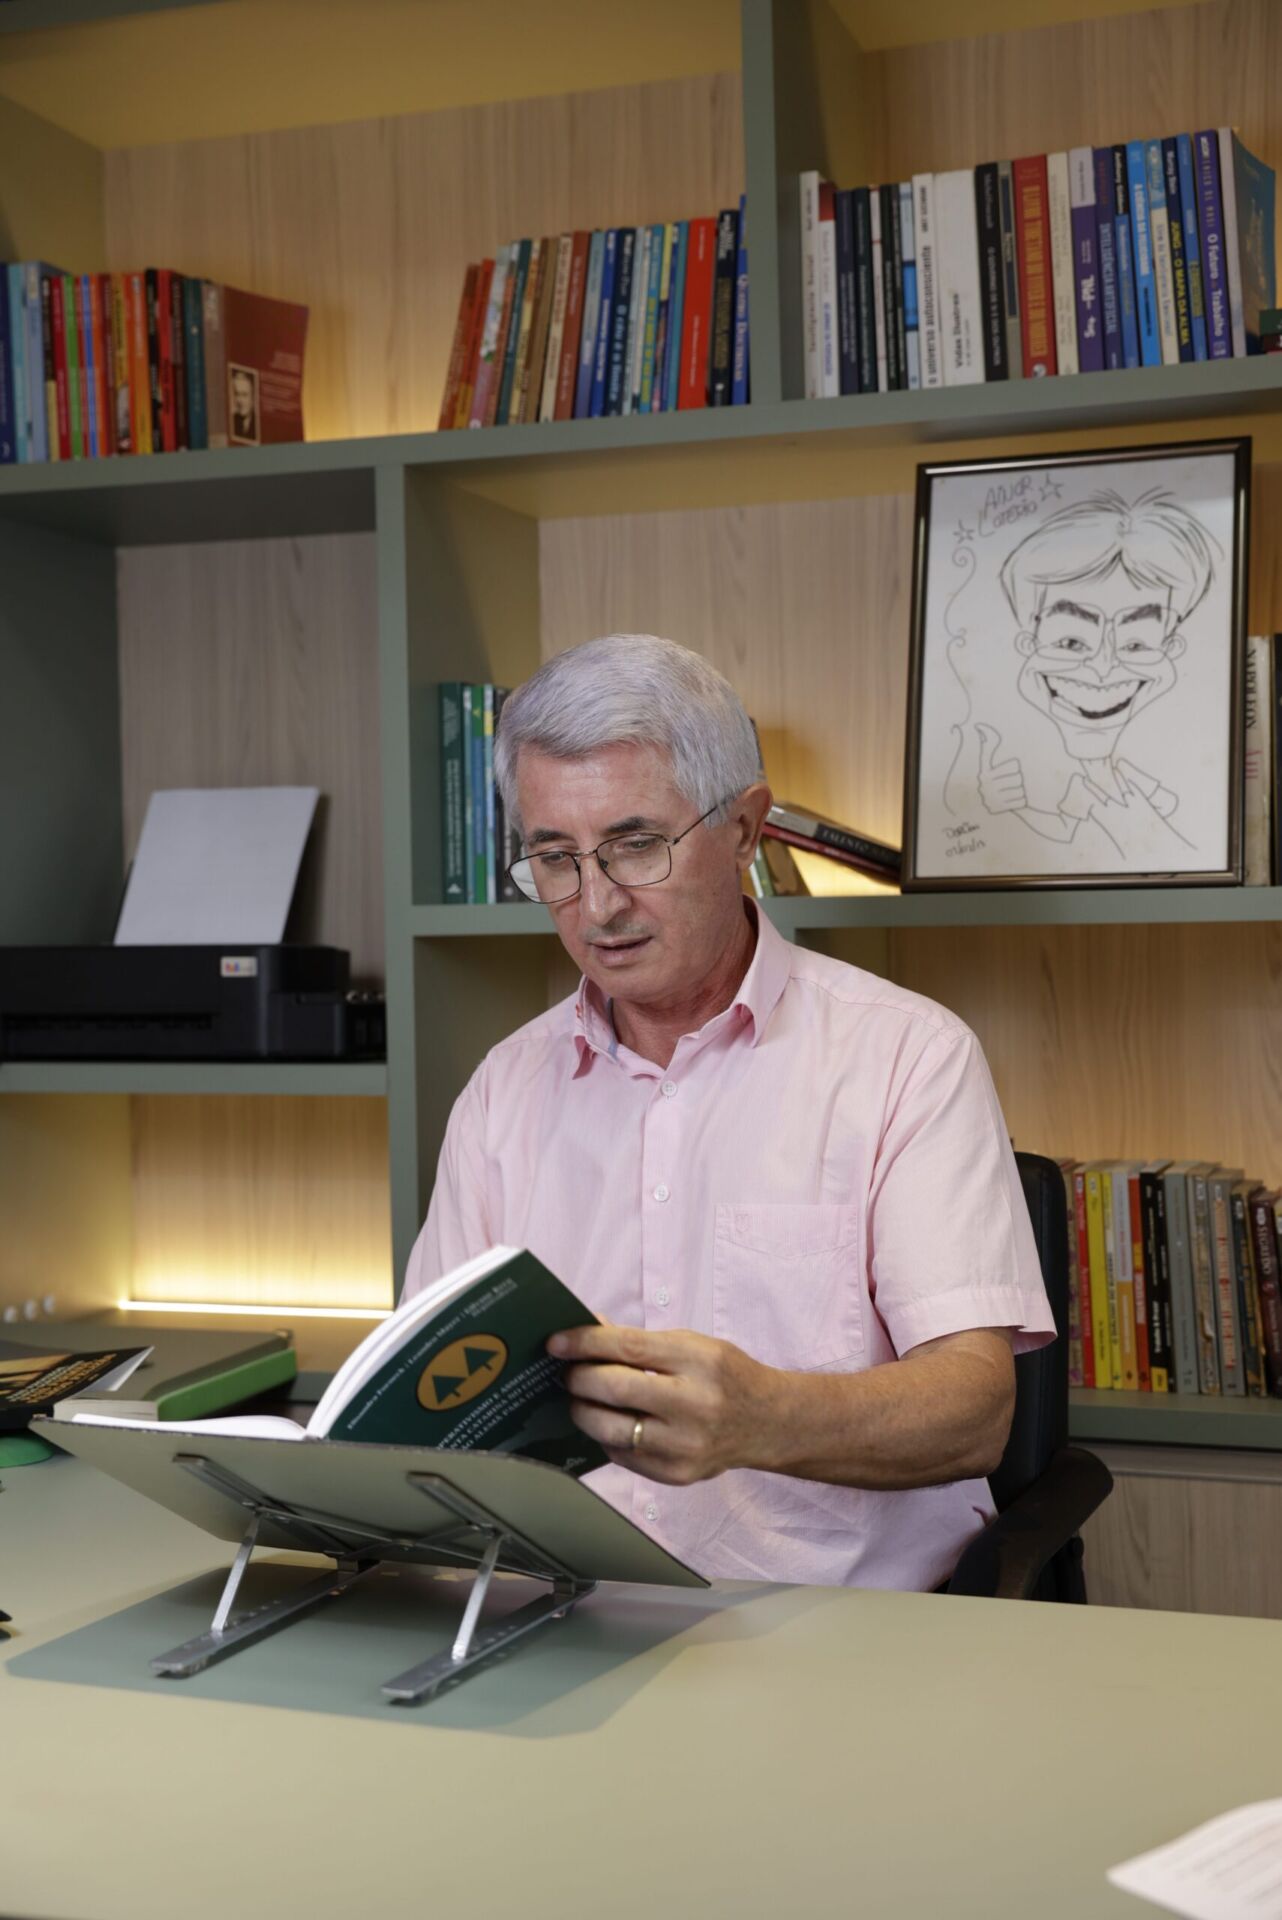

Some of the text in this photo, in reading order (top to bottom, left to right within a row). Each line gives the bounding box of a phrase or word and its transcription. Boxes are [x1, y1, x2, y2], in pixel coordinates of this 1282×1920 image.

[1207, 233, 1217, 241] O
[1207, 244, 1221, 280] Futuro
[922, 245, 934, 326] autoconsciente
[1174, 268, 1185, 297] MAPA
[1176, 298, 1186, 315] DA
[1211, 288, 1225, 337] Trabalho
[1178, 315, 1189, 344] ALMA
[927, 329, 937, 375] universo
[953, 338, 963, 368] Vidas
[1256, 1225, 1272, 1275] SEGREDO
[463, 1397, 511, 1435] CATARINA
